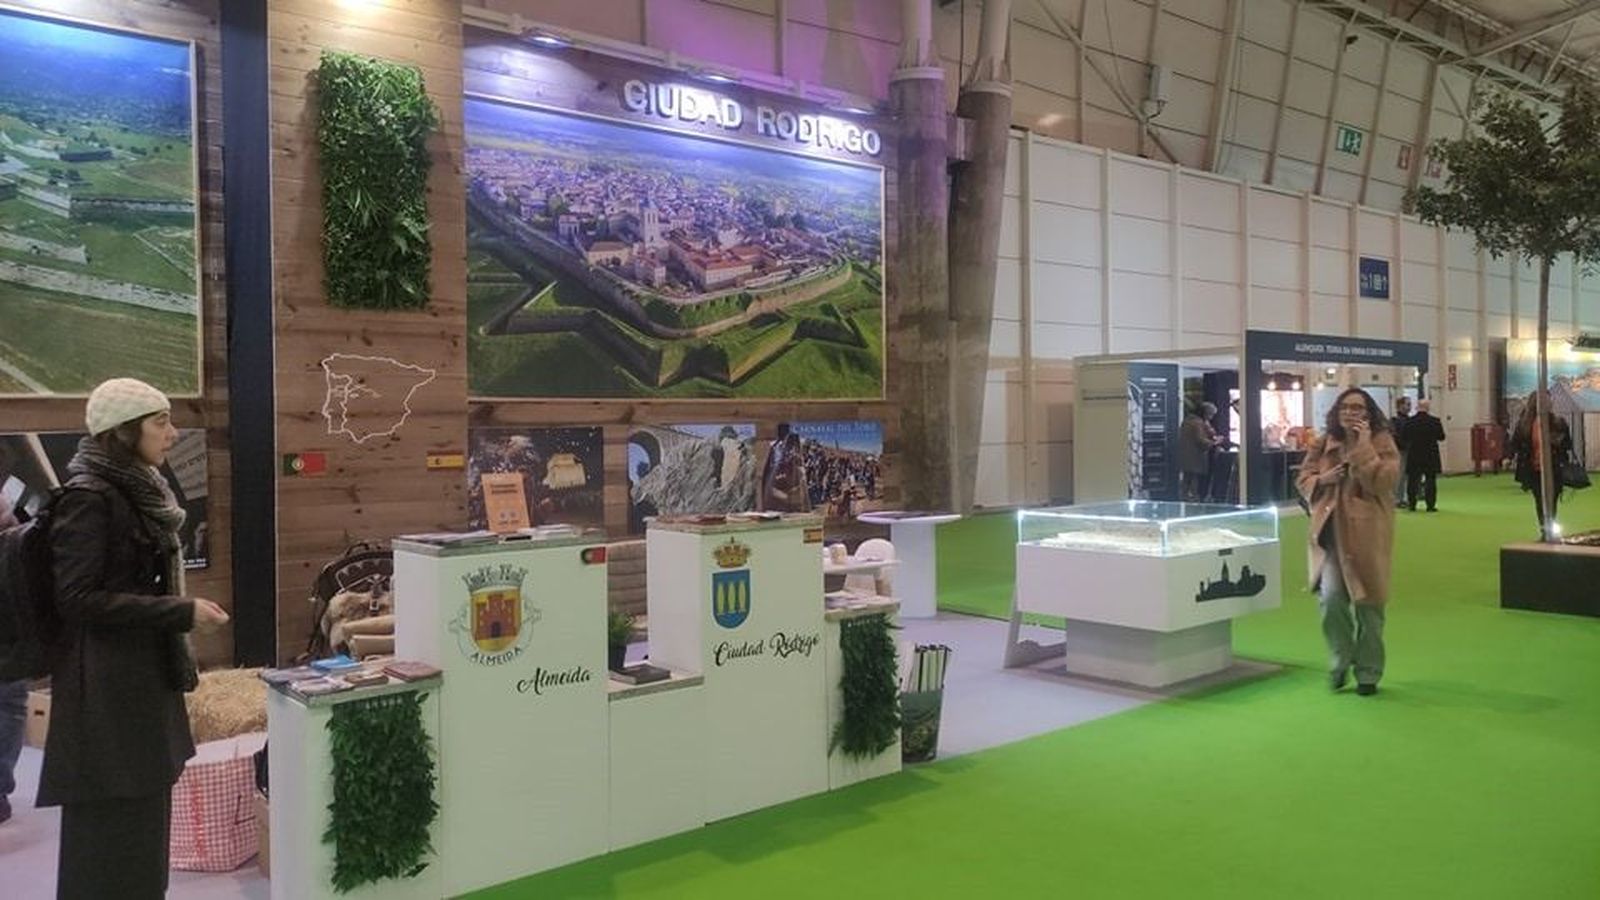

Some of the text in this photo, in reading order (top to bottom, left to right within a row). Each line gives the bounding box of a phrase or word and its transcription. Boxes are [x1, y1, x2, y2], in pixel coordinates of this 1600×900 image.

[623, 79, 881, 156] CIUDAD RODRIGO
[469, 646, 523, 666] ALMEIDA
[713, 632, 819, 667] Ciudad Rodrigo
[516, 666, 591, 695] Almeida
